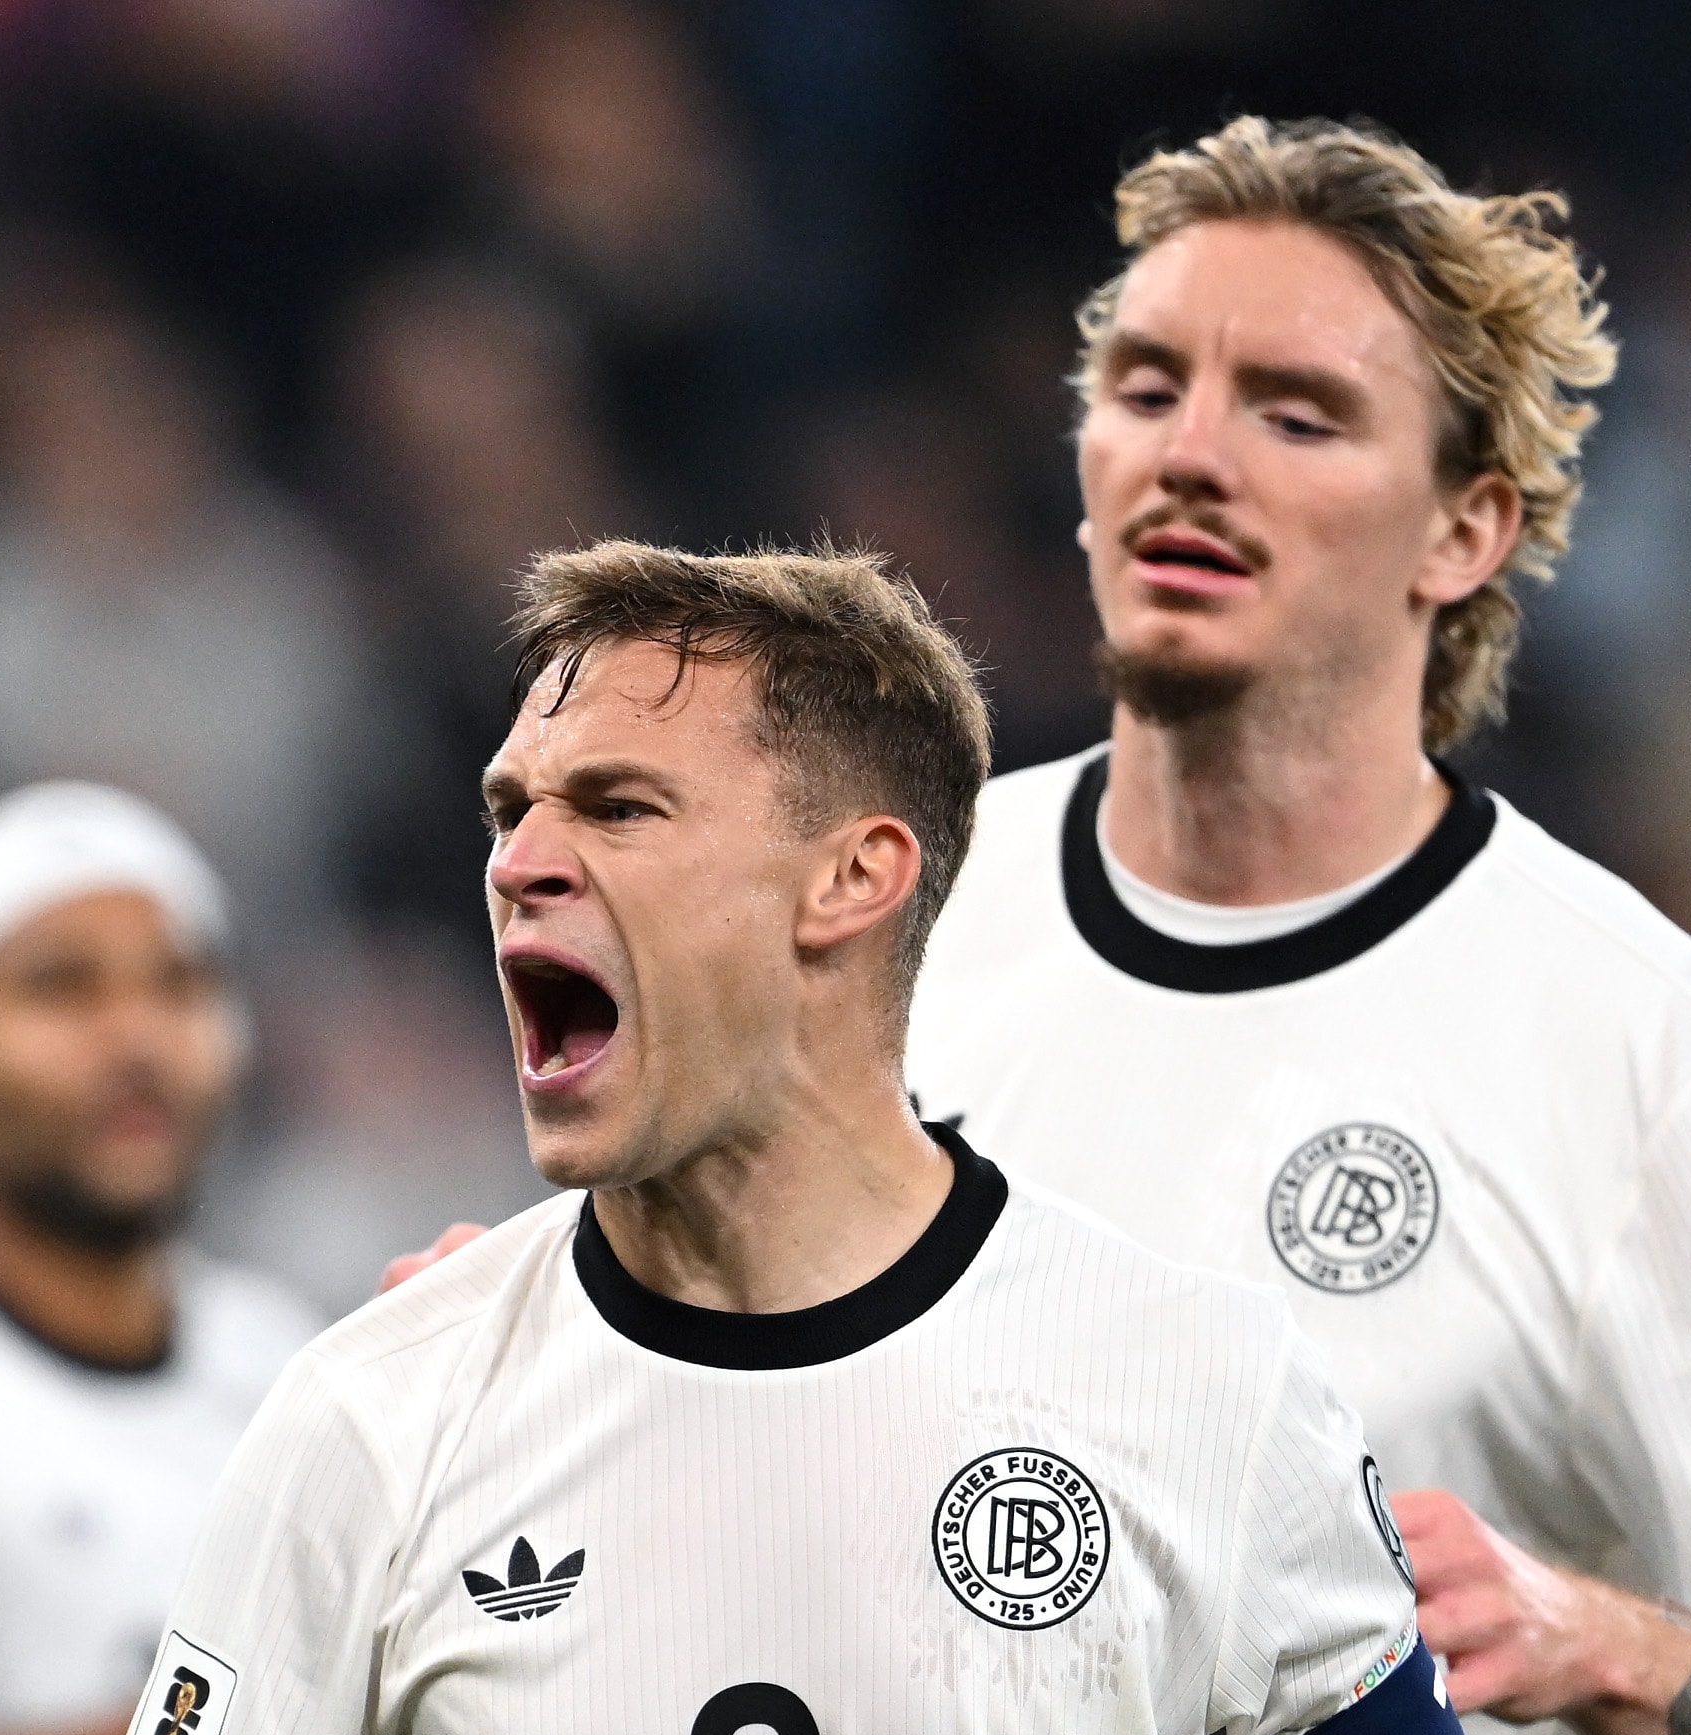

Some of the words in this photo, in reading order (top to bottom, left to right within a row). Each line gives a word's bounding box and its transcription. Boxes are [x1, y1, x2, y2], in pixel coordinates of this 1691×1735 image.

[942, 1463, 998, 1600] DEUTSCHER
[1007, 1456, 1101, 1610] FUSSBALL-BUND
[1000, 1600, 1035, 1621] 125
